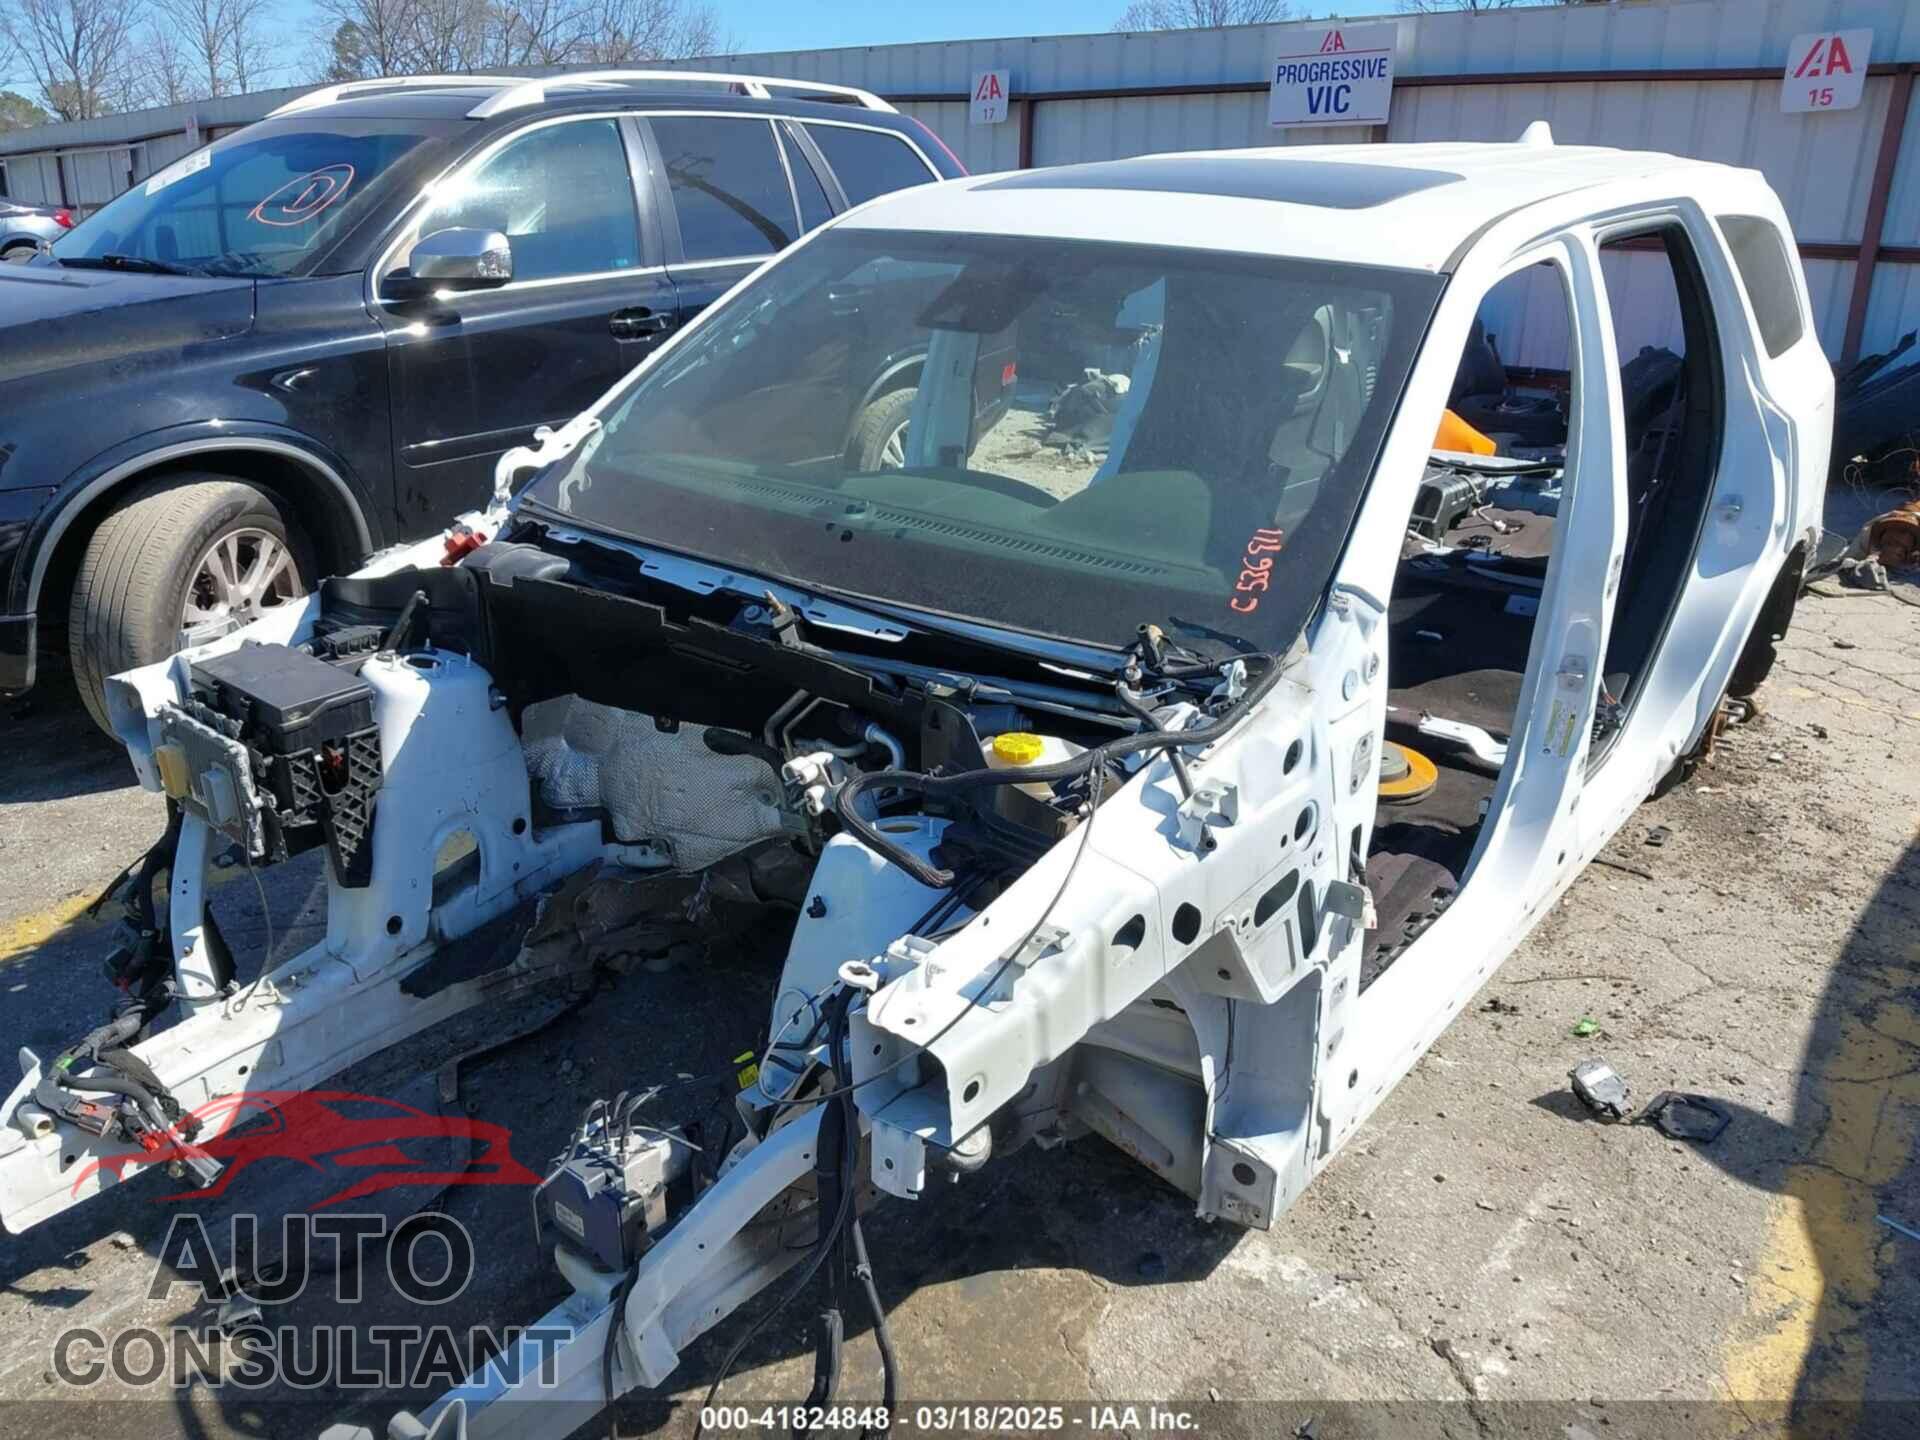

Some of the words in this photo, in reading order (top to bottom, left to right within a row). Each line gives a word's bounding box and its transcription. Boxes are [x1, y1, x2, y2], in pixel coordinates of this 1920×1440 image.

[1276, 57, 1388, 84] PROGRESSIVE
[1307, 84, 1352, 114] VIC
[1808, 87, 1834, 106] 15
[984, 108, 996, 120] 17
